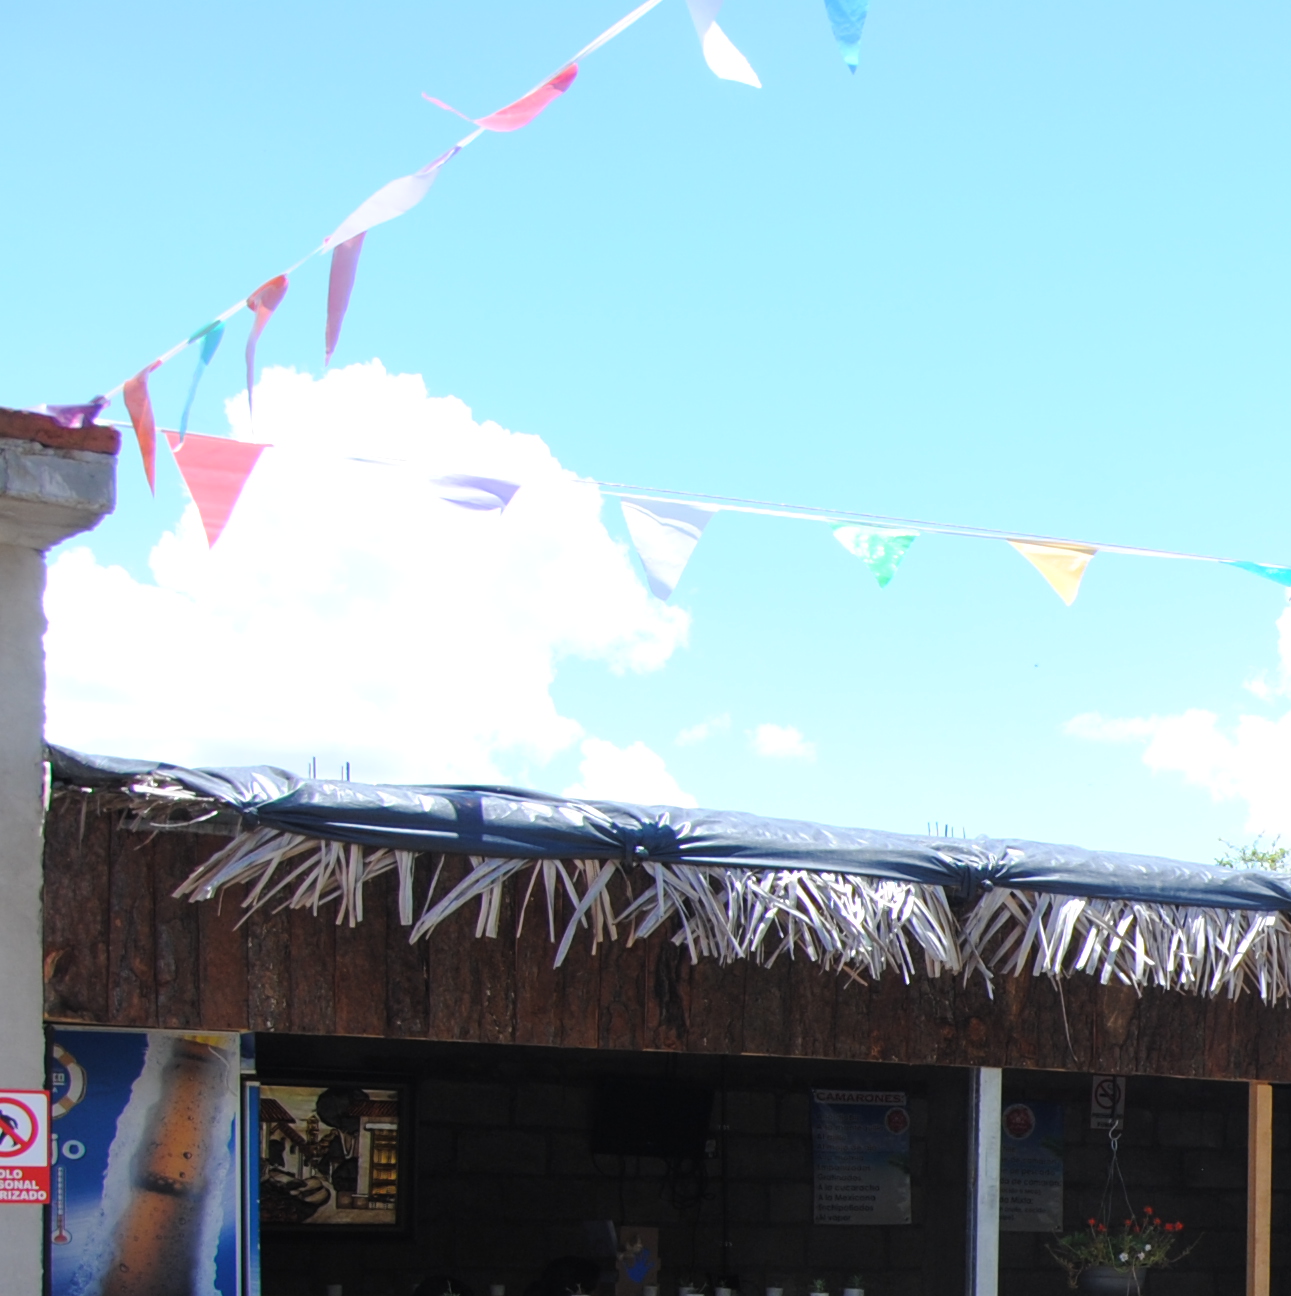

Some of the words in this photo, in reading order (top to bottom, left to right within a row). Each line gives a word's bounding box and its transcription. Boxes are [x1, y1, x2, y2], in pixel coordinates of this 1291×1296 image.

[817, 1092, 904, 1103] CAMARONES:
[834, 1184, 880, 1192] cucaracha
[834, 1194, 876, 1202] Mexicana
